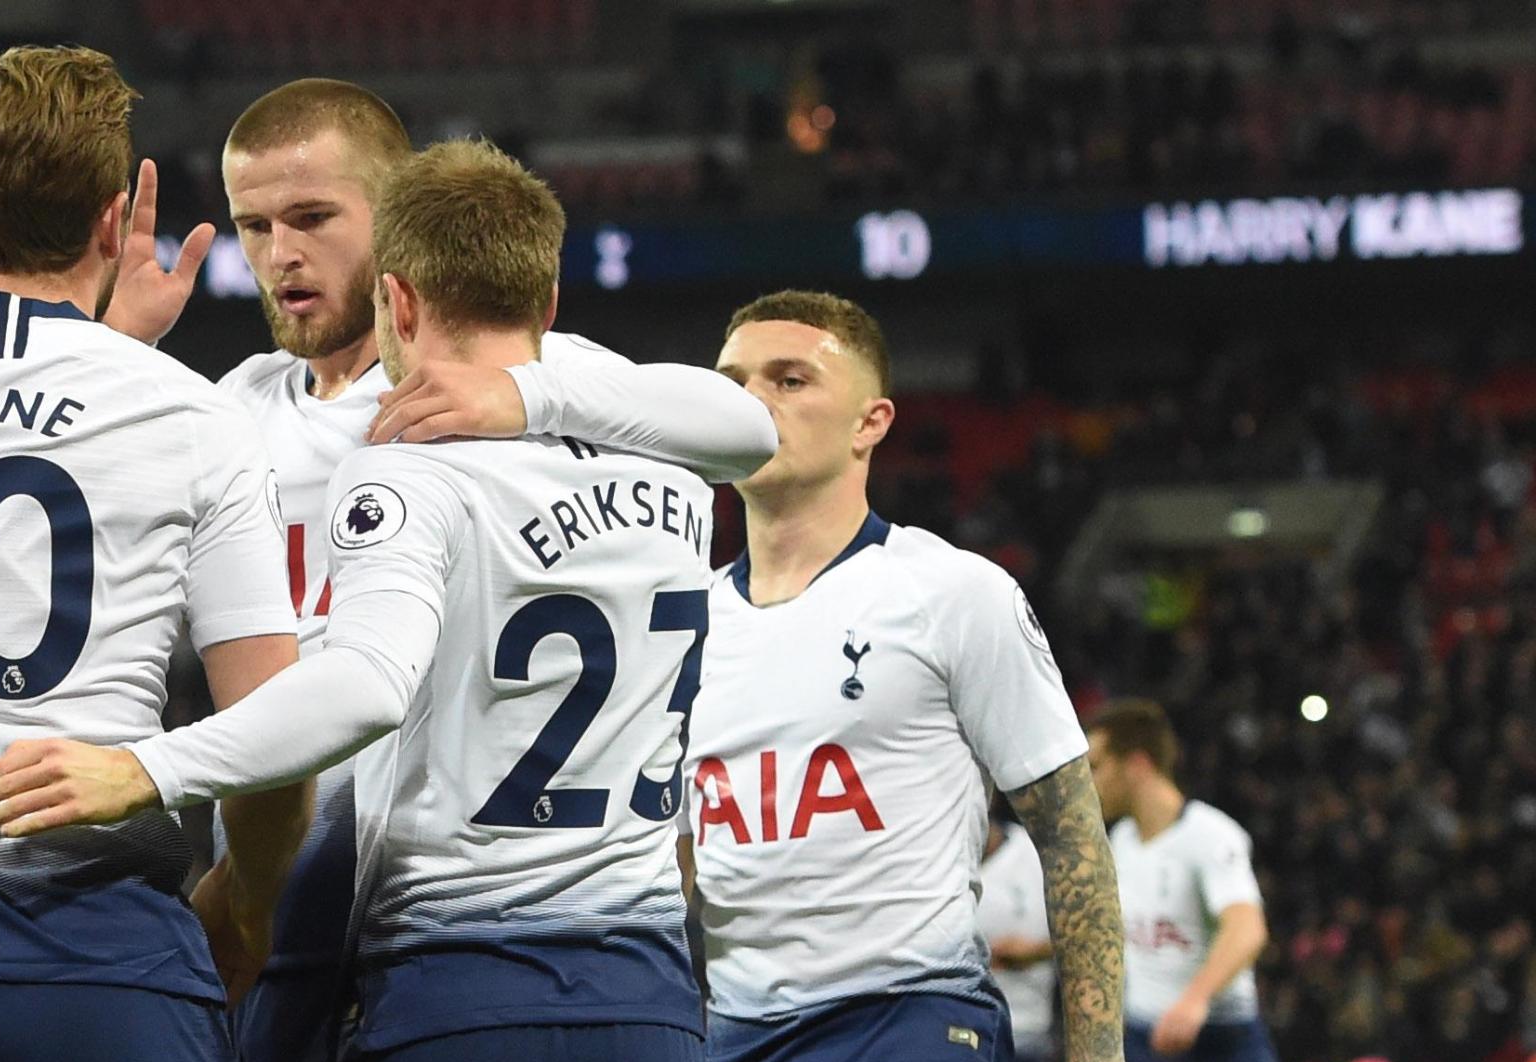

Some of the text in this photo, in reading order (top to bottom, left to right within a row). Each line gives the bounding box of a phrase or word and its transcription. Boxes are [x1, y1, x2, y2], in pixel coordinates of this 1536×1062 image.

[857, 209, 931, 280] 10
[1144, 190, 1524, 266] HARRY KANE
[519, 480, 703, 570] ERIKSEN
[470, 589, 710, 828] 23
[694, 743, 886, 847] AIA
